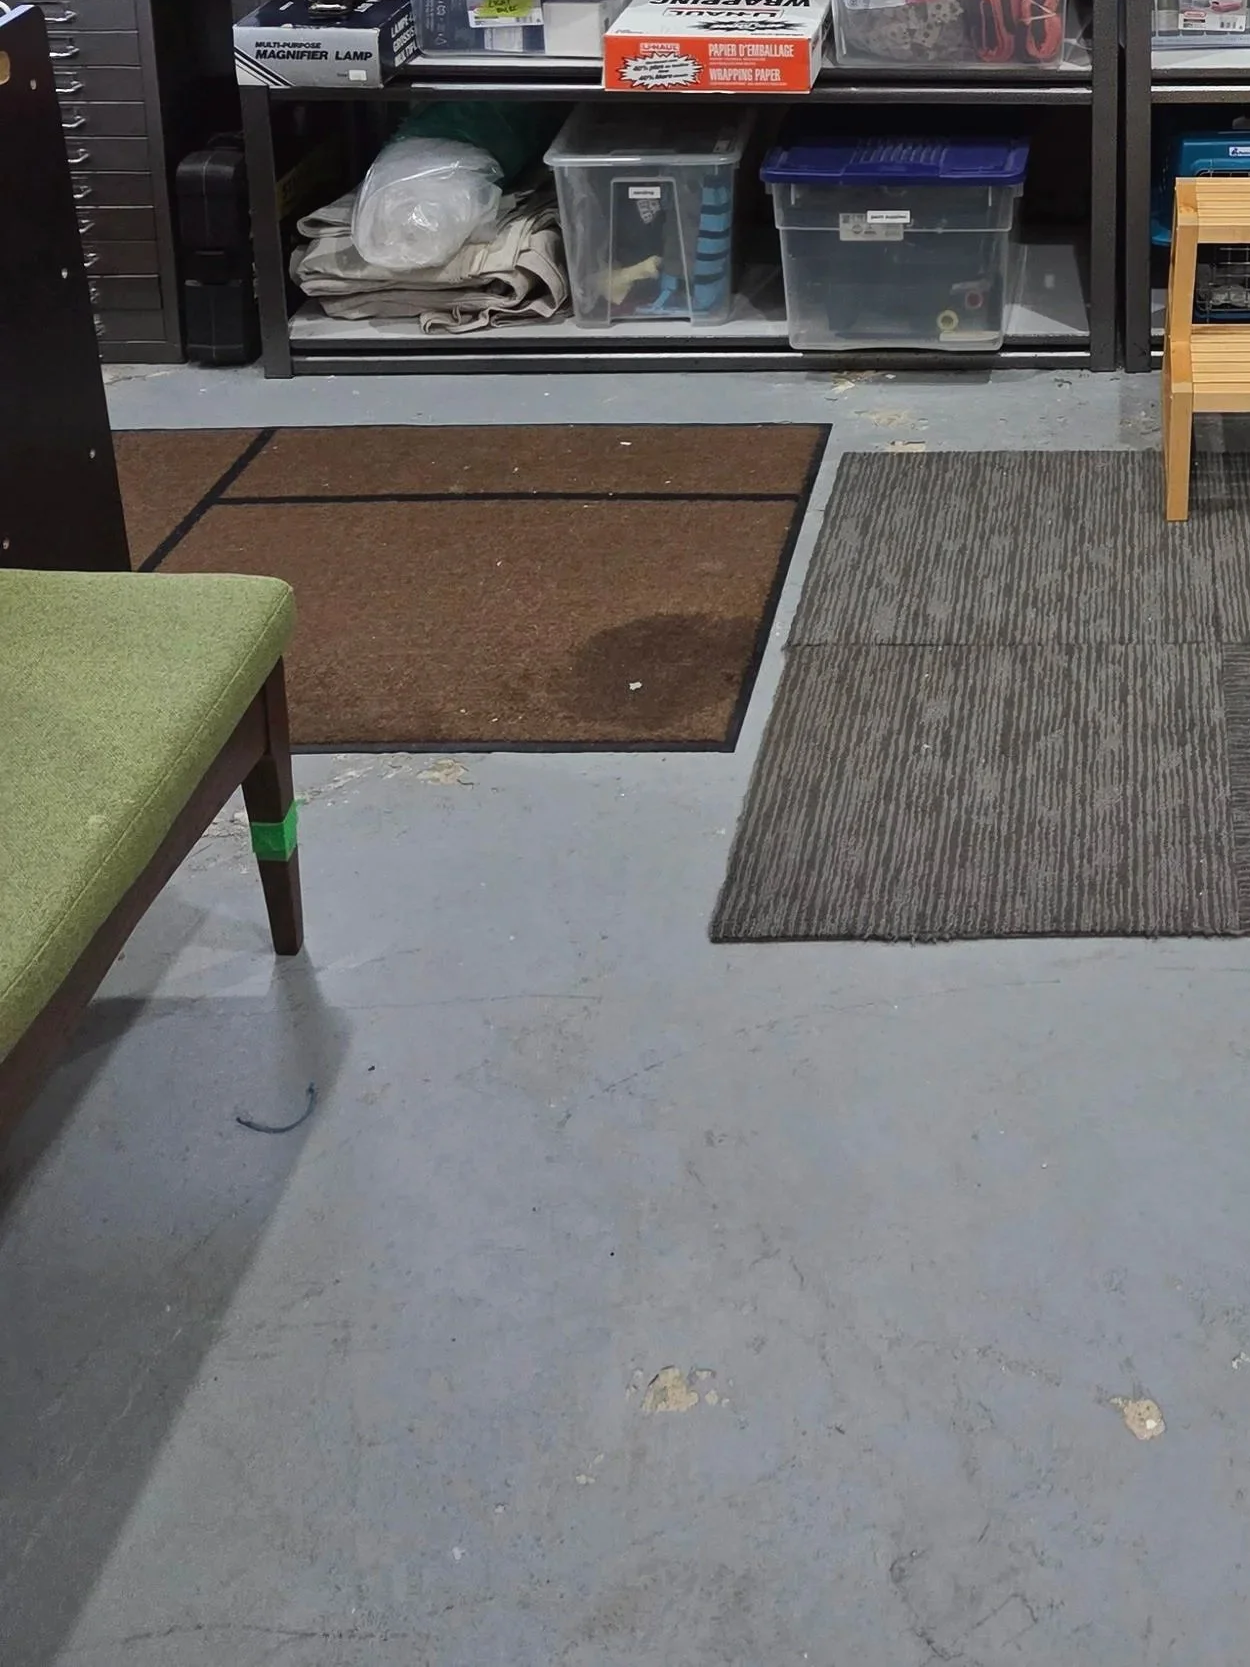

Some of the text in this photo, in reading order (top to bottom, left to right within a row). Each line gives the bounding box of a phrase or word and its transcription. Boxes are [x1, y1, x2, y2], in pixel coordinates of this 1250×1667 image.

[254, 41, 322, 50] MULTI-PURPOSE
[708, 43, 795, 58] PAPIER D'EMBALLAGE
[254, 49, 373, 62] MAGNIFIER LAMP
[708, 68, 782, 82] WRAPPING PAPER
